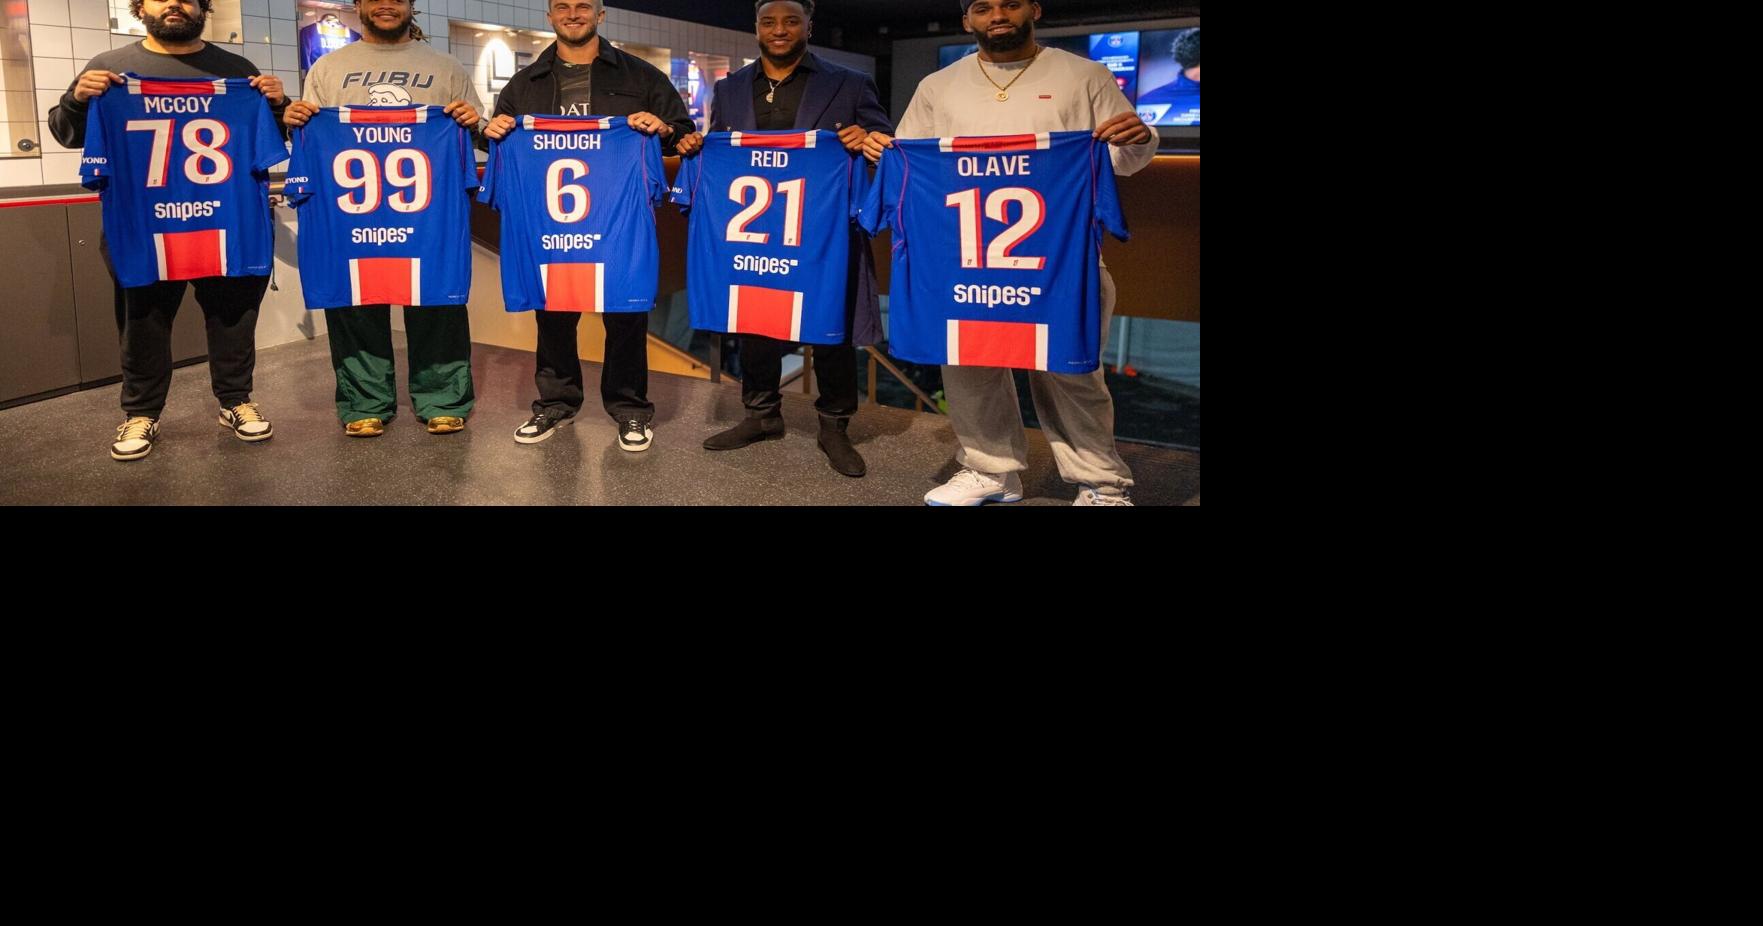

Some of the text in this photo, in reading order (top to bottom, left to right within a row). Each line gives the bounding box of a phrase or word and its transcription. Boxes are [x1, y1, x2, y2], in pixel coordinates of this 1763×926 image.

[342, 71, 434, 89] FUBU
[144, 97, 212, 113] MCCOY
[353, 127, 412, 143] YOUNG
[533, 134, 601, 150] SHOUGH
[126, 118, 233, 188] 78
[751, 150, 789, 168] REID
[957, 155, 1031, 176] OLAVE
[332, 148, 432, 214] 99
[546, 158, 590, 223] 6
[155, 201, 213, 221] snipes
[726, 175, 806, 247] 21
[352, 227, 407, 245] snipes
[945, 187, 1047, 270] 12
[541, 234, 593, 252] snipes
[733, 254, 791, 275] snipes
[953, 284, 1031, 308] snipes
